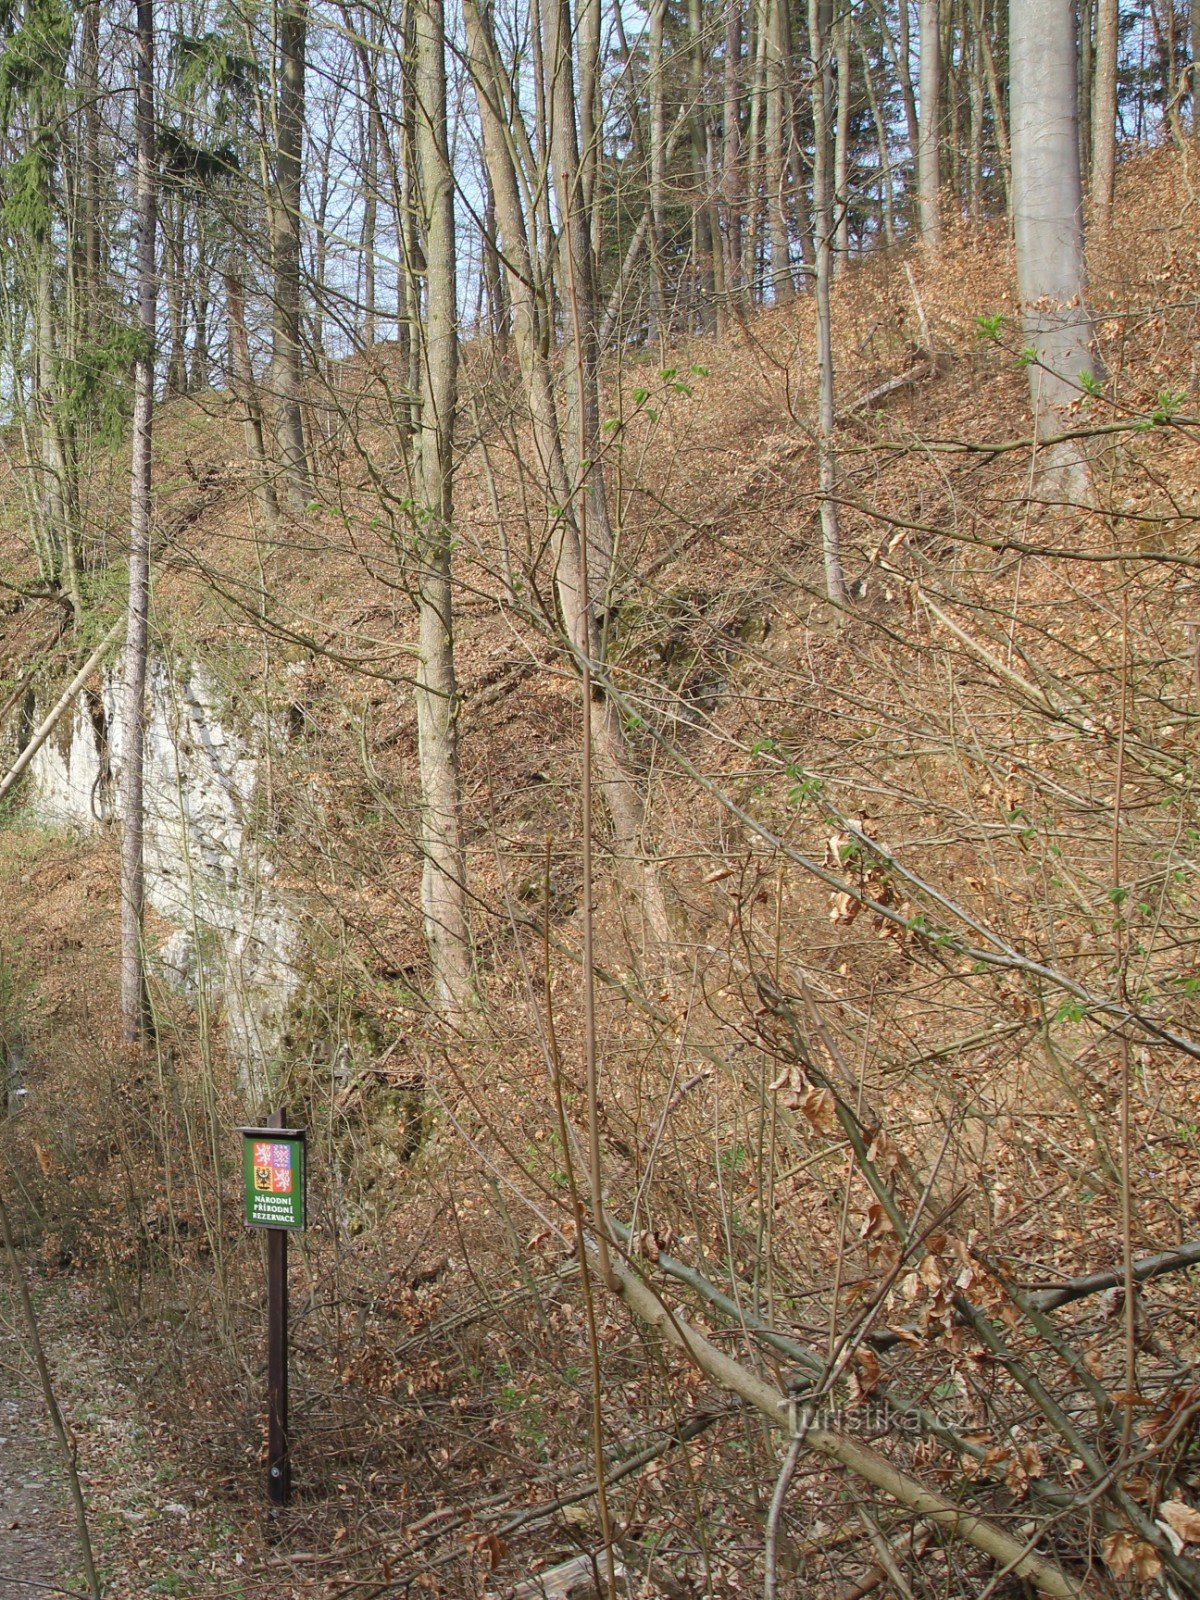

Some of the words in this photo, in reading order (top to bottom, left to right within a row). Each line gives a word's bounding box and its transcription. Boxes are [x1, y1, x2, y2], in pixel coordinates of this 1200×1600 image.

[254, 1194, 292, 1205] NÁRODNÍ
[253, 1203, 293, 1214] PŘÍRODNÍ
[252, 1212, 295, 1223] REZERVACE
